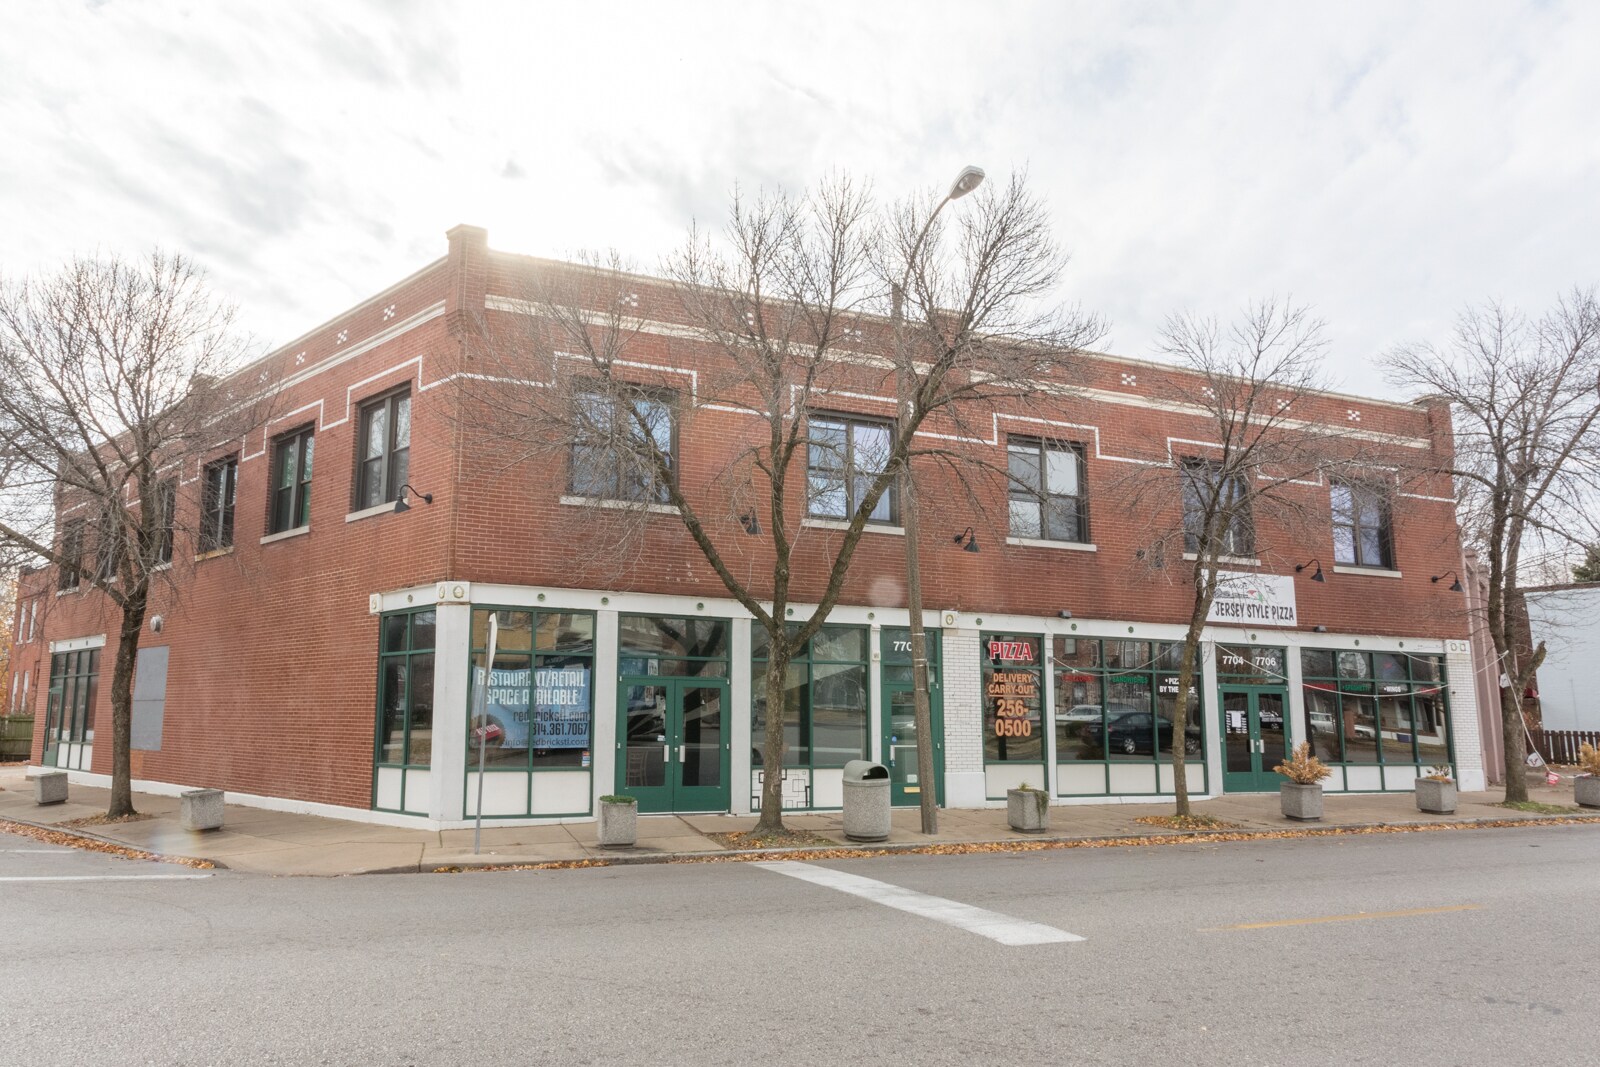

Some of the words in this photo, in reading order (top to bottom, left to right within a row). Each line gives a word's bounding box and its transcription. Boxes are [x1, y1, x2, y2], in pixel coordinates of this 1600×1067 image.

[1215, 601, 1245, 618] JERSEY
[1246, 603, 1270, 619] STYLE
[1271, 605, 1295, 621] PIZZA
[893, 641, 912, 652] 770
[989, 641, 1033, 661] PIZZA
[1222, 655, 1244, 666] 7704
[1255, 656, 1276, 667] 7706
[477, 669, 586, 687] RSTAURANT/RETAIL
[993, 673, 1033, 683] DELIVERY
[988, 684, 1035, 694] CARRY-OUT
[1159, 685, 1167, 693] BY
[522, 689, 578, 705] AAILABLE
[513, 708, 588, 722] redrickstl.com
[997, 699, 1029, 717] 256-
[995, 719, 1031, 737] 0500
